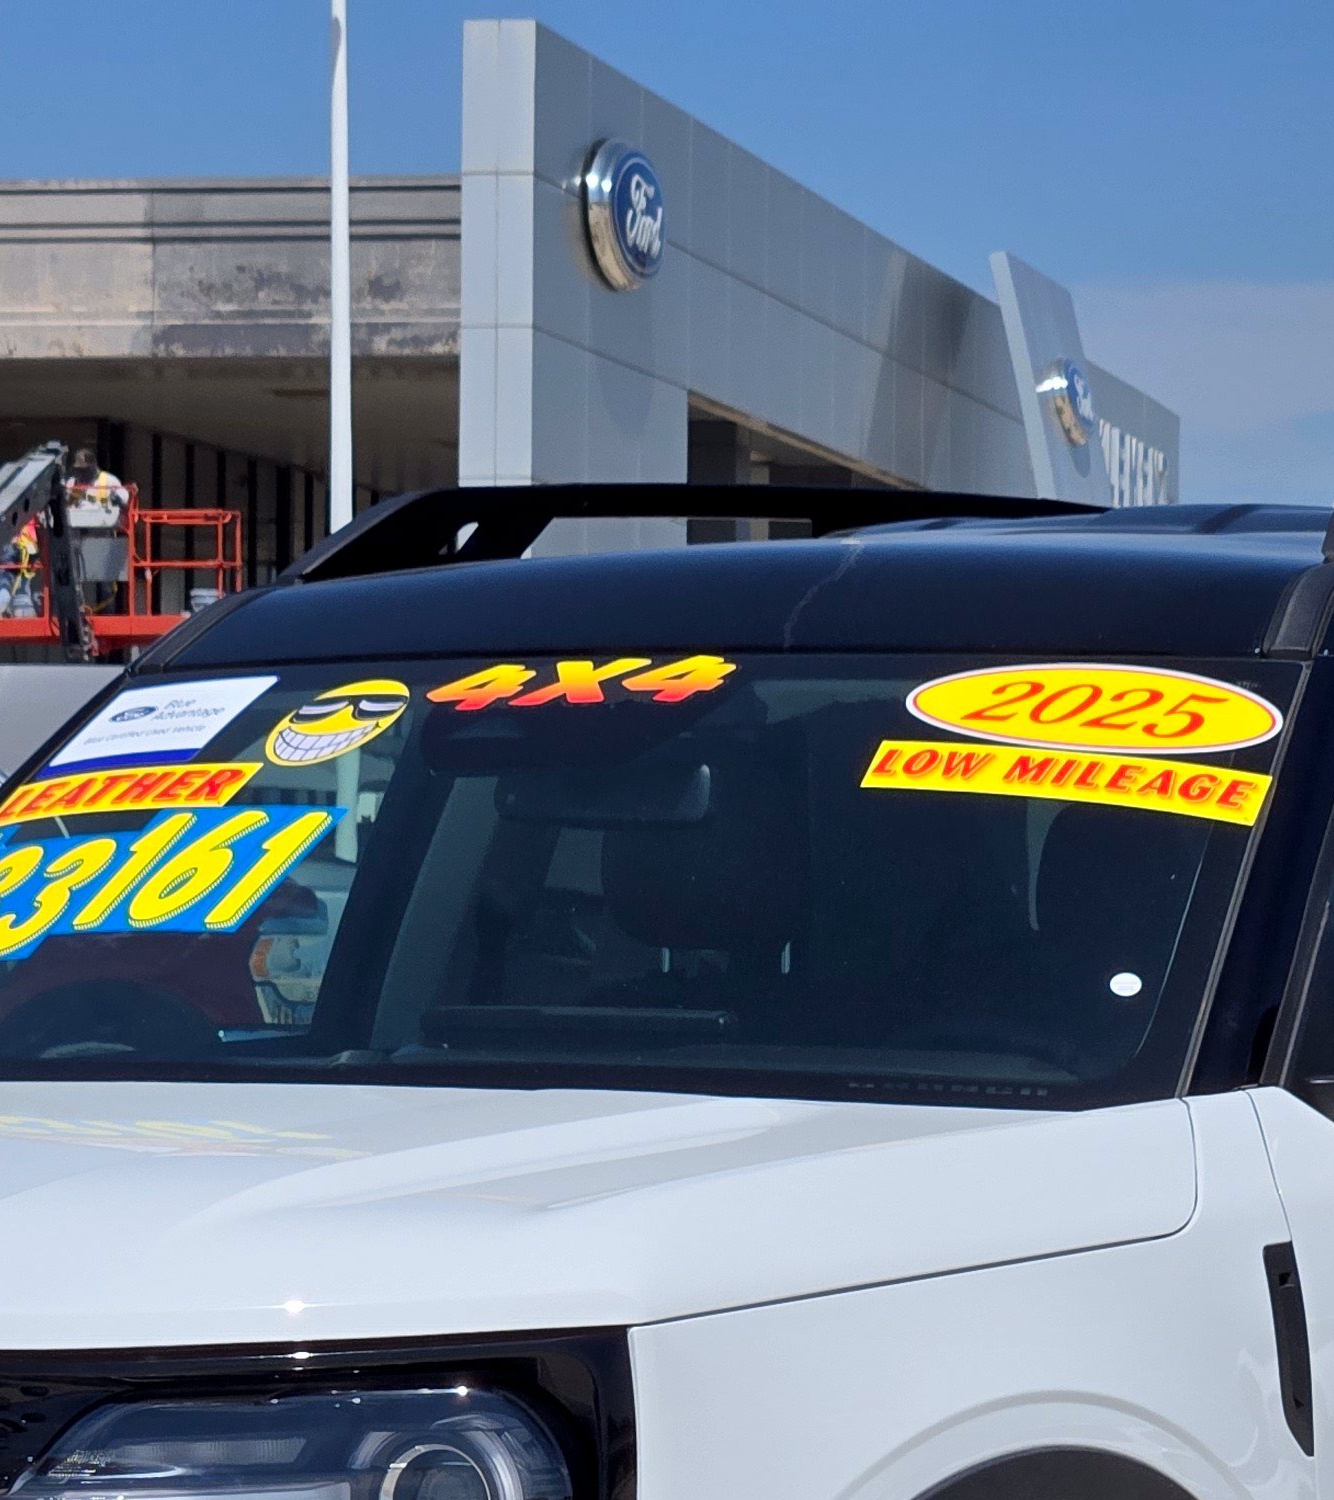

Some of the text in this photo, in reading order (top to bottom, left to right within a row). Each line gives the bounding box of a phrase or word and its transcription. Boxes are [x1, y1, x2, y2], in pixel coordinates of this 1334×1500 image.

[625, 173, 663, 259] Ford
[960, 680, 1230, 738] 2025
[871, 749, 1257, 809] LOW MILEAGE
